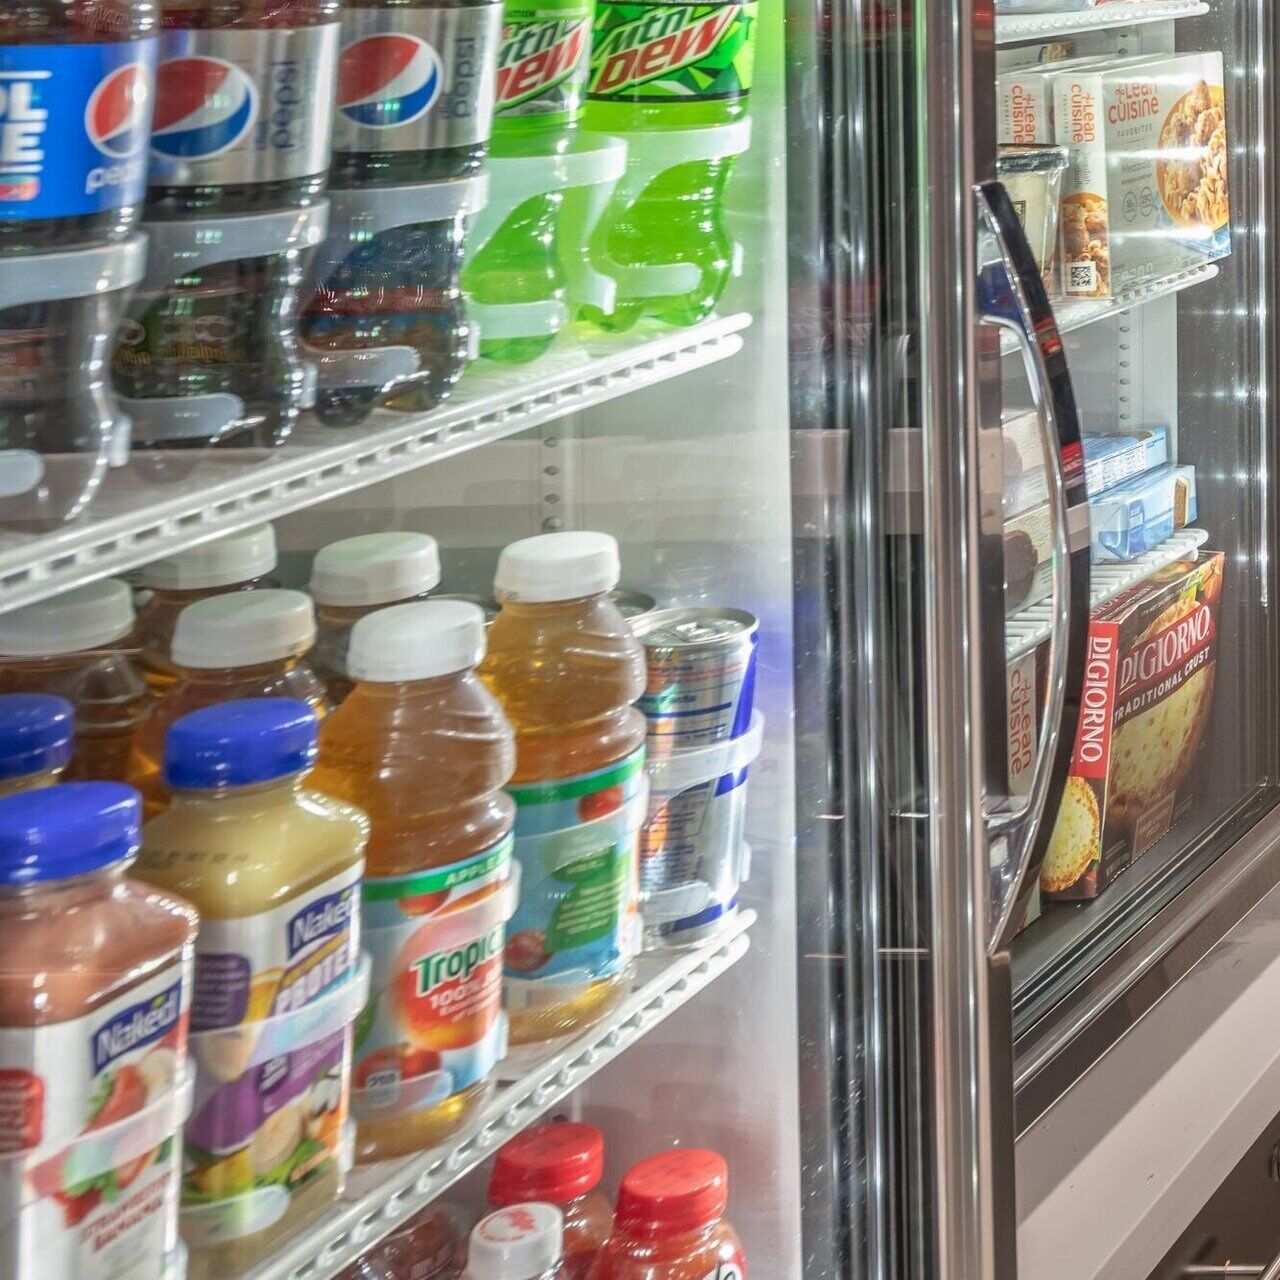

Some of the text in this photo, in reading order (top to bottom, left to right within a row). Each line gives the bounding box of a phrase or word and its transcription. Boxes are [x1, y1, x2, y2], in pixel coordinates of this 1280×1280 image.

[451, 36, 476, 118] pepsi
[594, 5, 745, 94] Dew
[270, 59, 297, 153] pepsi
[1010, 84, 1025, 145] cuisine
[1023, 103, 1036, 145] Lean
[1070, 83, 1084, 145] cuisine
[1082, 103, 1096, 144] Lean
[1107, 97, 1160, 125] cuisine
[1125, 81, 1160, 101] Lean
[1113, 645, 1211, 724] TRADITIONAL CRUST
[1118, 604, 1211, 696] DIGIORNO
[1009, 667, 1021, 777] cuisine
[1019, 697, 1033, 771] Lean
[1079, 635, 1113, 764] DIGIORNO
[95, 990, 179, 1066] Naked
